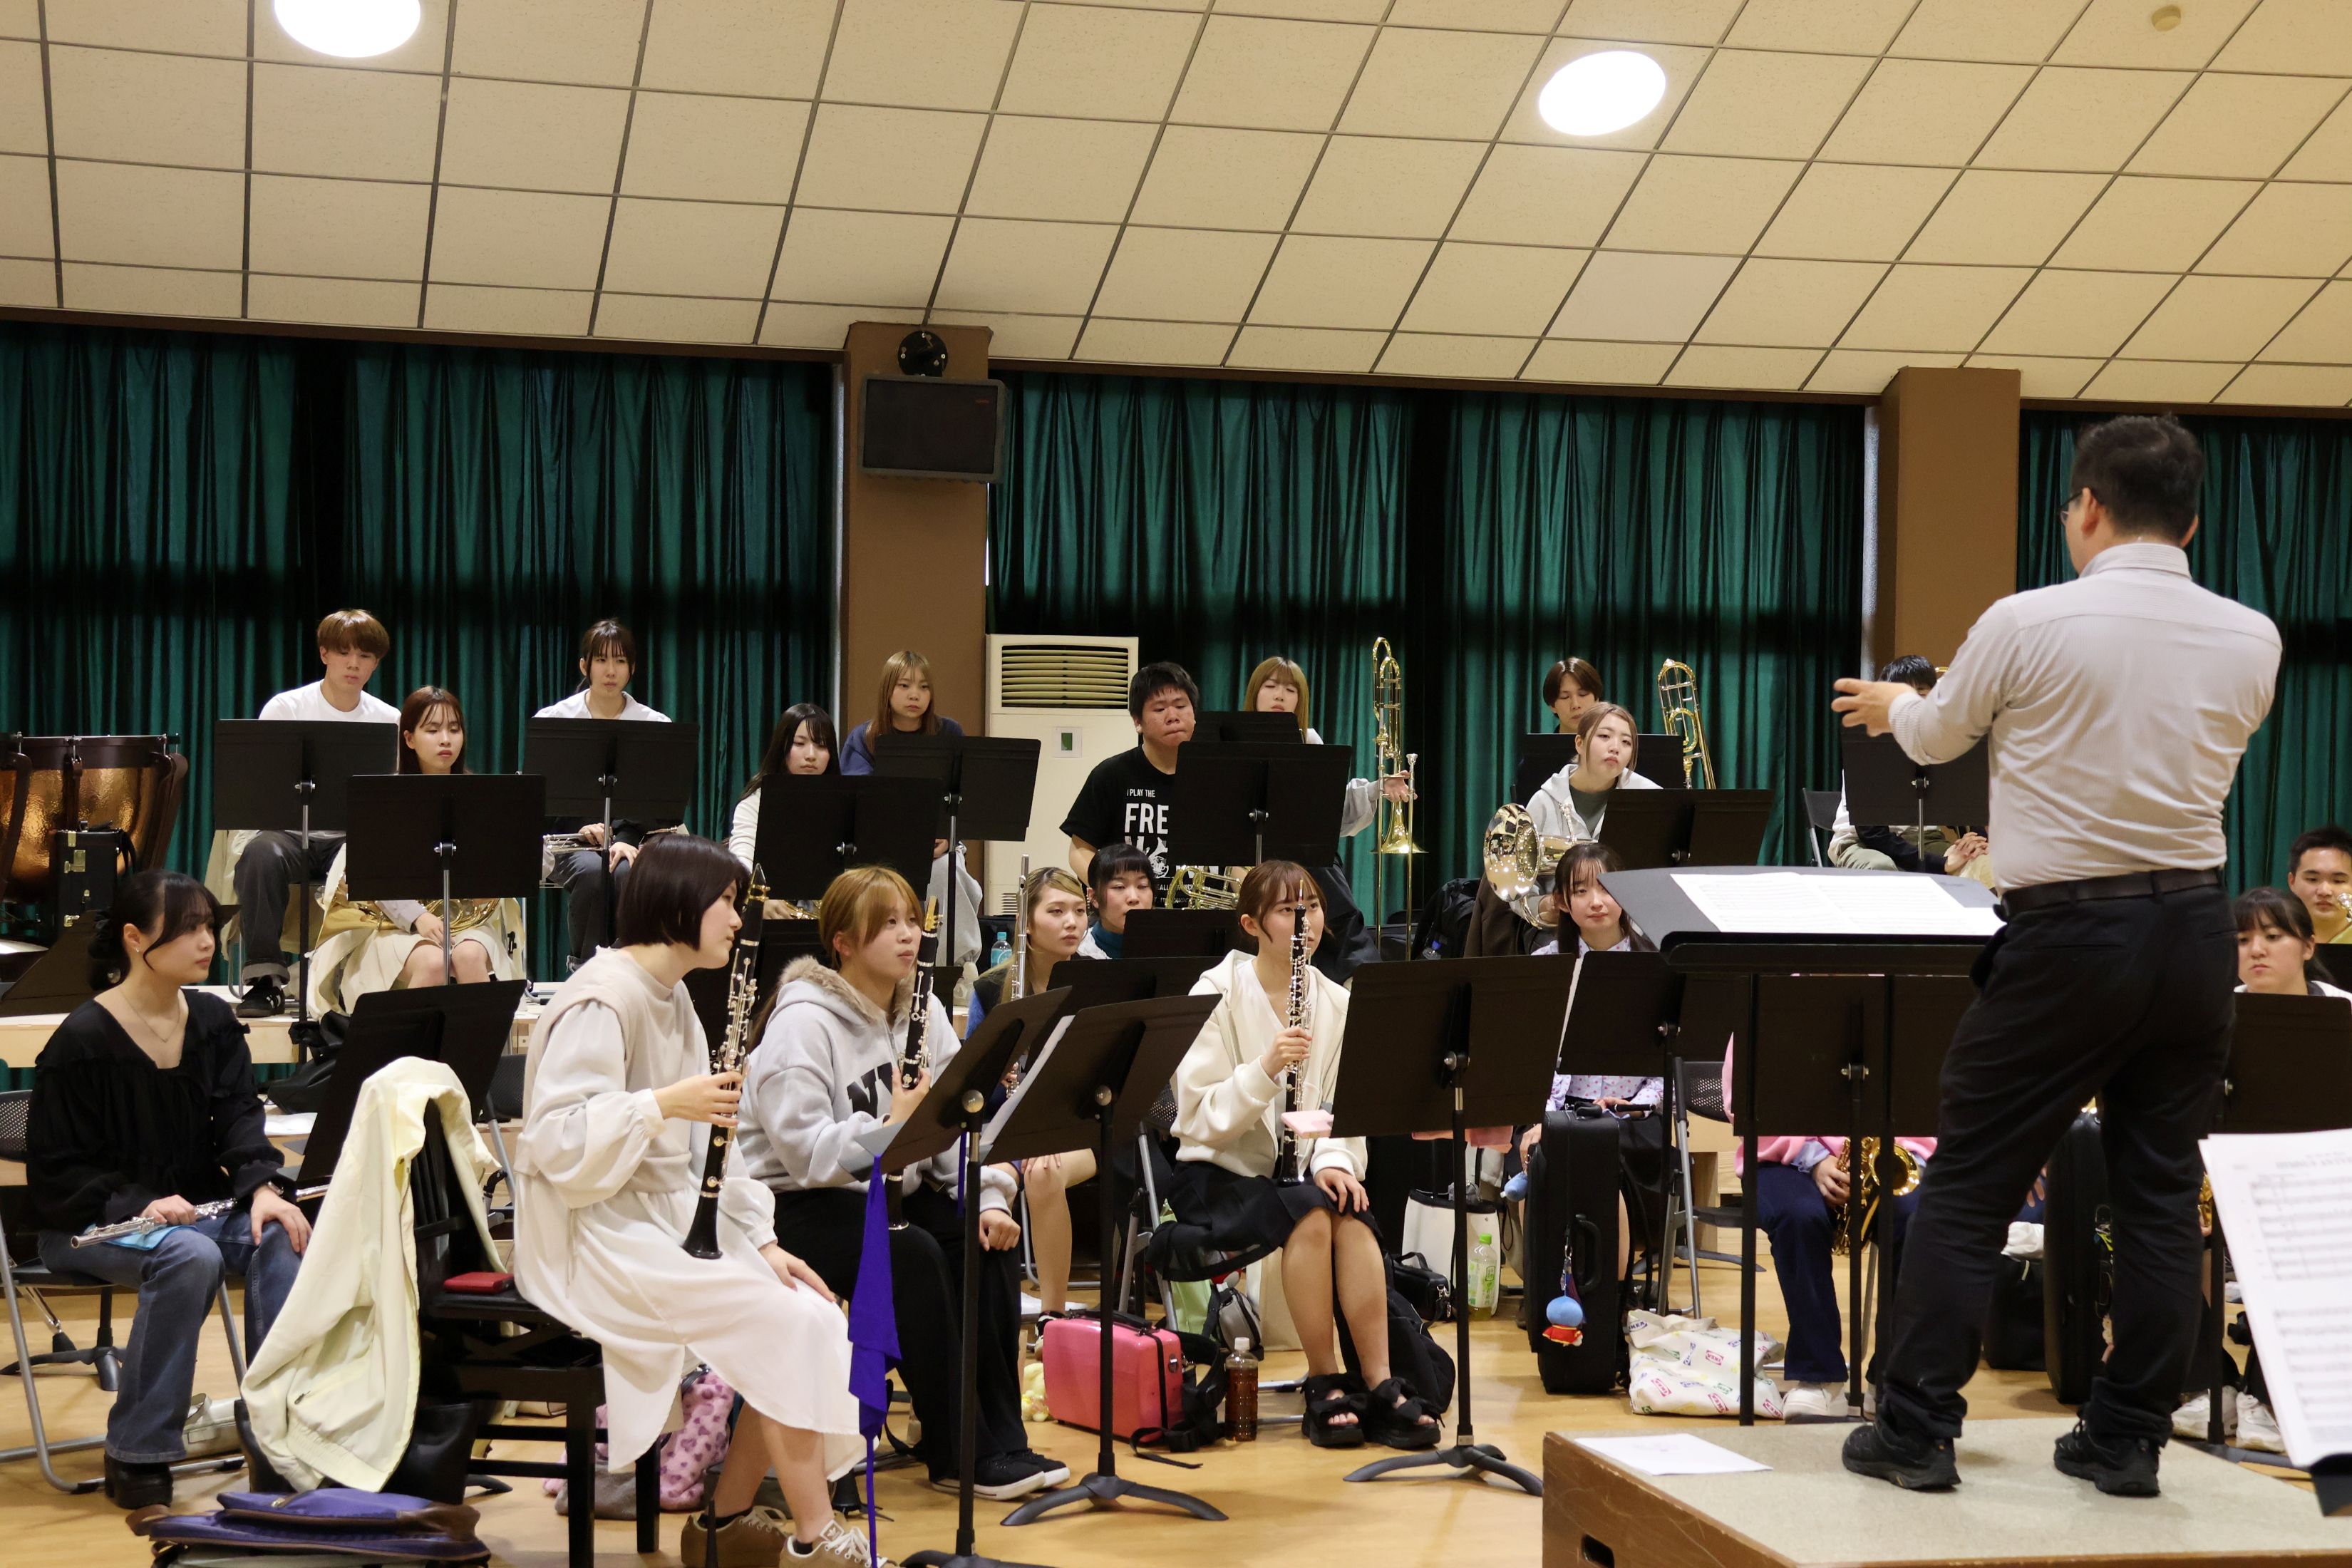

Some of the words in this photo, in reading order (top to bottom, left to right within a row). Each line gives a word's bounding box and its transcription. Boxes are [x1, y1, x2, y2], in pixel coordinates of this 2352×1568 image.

[1130, 788, 1144, 797] PLAY
[1145, 789, 1156, 798] THE
[1125, 803, 1170, 835] FRE
[1706, 1353, 1721, 1362] IKEA
[1712, 1395, 1725, 1412] IKEA
